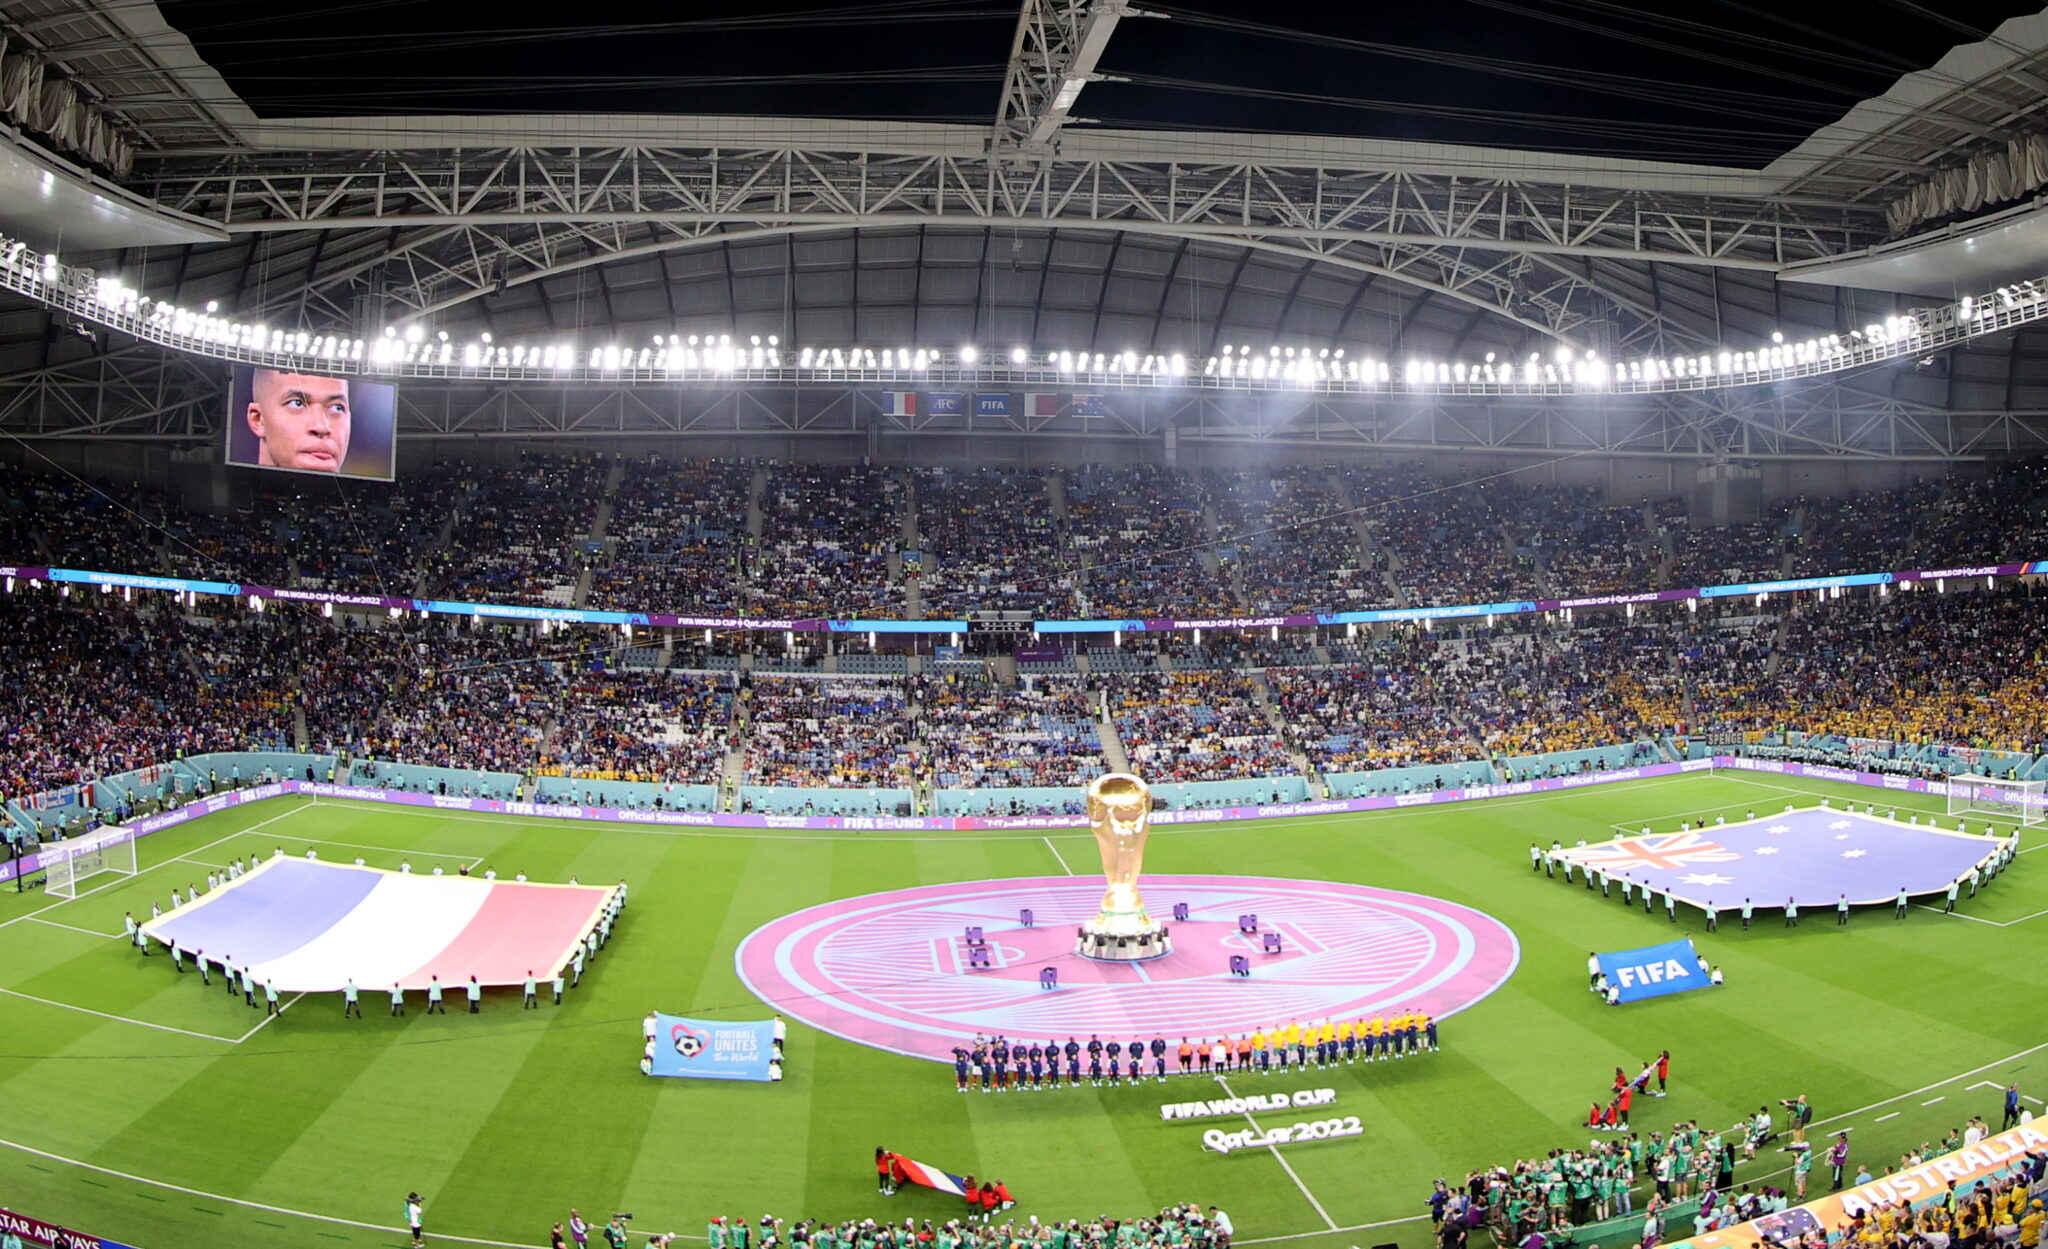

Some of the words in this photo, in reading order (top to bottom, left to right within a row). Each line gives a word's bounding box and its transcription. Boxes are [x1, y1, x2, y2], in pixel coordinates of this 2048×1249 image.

[982, 400, 1004, 409] FIFA
[290, 591, 314, 599] WORLD
[695, 617, 720, 625] WORLD
[1191, 619, 1216, 627] WORLD
[1708, 733, 1742, 745] SPENGE
[1735, 758, 1753, 768] FIFA
[1562, 775, 1592, 786] Official
[1593, 769, 1640, 782] Soundtrack
[1802, 766, 1823, 776] Official
[1823, 769, 1857, 781] Soundtrack
[299, 781, 332, 793] Official
[334, 785, 386, 799] Soundtrack
[1464, 786, 1489, 798] FIFA
[1927, 780, 1946, 794] FIFA
[240, 788, 255, 803] FIFA
[505, 801, 533, 814] FIFA
[1258, 805, 1293, 816] Official
[1294, 800, 1349, 813] Soundtrack
[618, 810, 654, 820] Official
[655, 811, 713, 823] Soundtrack
[843, 817, 873, 828] FIFA
[1147, 811, 1173, 823] FIFA
[1616, 959, 1690, 988] FIFA
[715, 1030, 756, 1039] FOOTBALL
[714, 1040, 757, 1051] UNITES
[1161, 1101, 1209, 1120] FIFA
[1208, 1093, 1290, 1115] WORLD
[1293, 1088, 1336, 1107] CUP
[1840, 1125, 2048, 1217] AUSTRALIA
